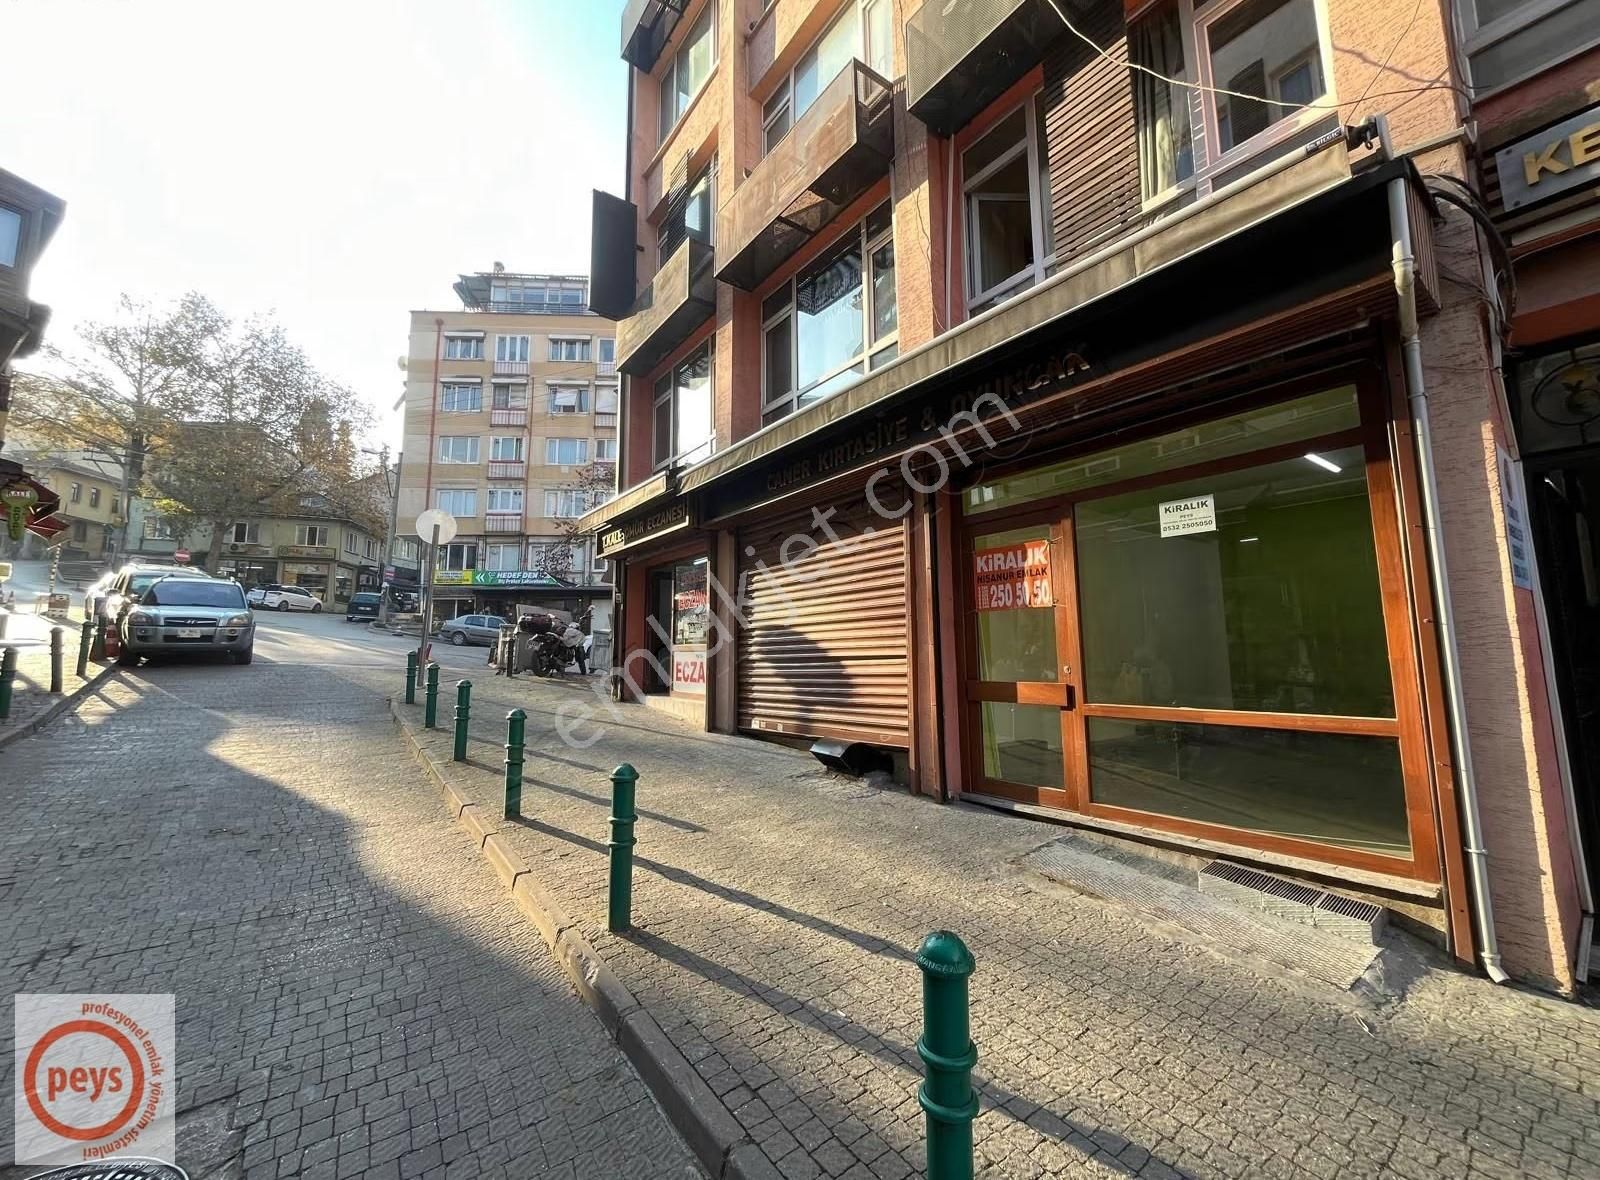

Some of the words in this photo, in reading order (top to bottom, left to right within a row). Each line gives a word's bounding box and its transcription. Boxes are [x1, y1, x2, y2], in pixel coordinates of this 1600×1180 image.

[919, 405, 936, 432] &
[496, 571, 522, 579] HEDEF
[1017, 567, 1048, 579] EMLAK
[990, 583, 1013, 608] 250
[1016, 581, 1030, 606] 50
[1033, 580, 1050, 606] 50
[675, 661, 705, 684] ECZA
